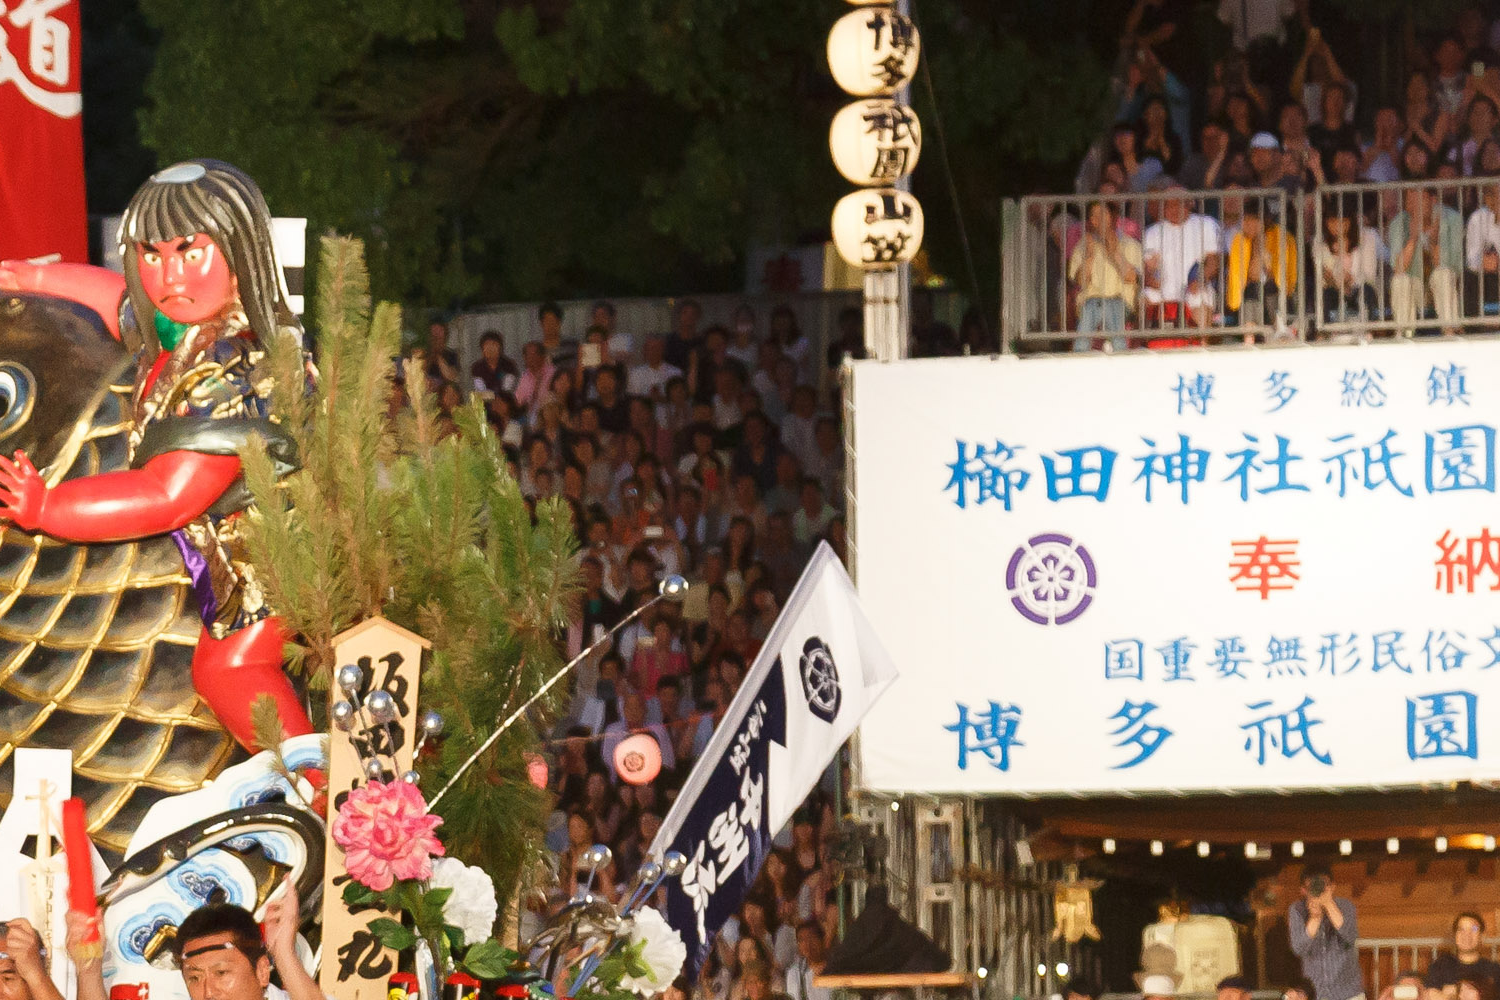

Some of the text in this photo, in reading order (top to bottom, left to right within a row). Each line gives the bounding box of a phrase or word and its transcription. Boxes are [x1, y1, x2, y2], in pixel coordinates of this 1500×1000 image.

[1171, 362, 1473, 415] 博多総鎮
[943, 423, 1497, 512] 櫛田神社祇園
[1229, 526, 1500, 601] 奉納
[943, 689, 1479, 772] 博多祇園
